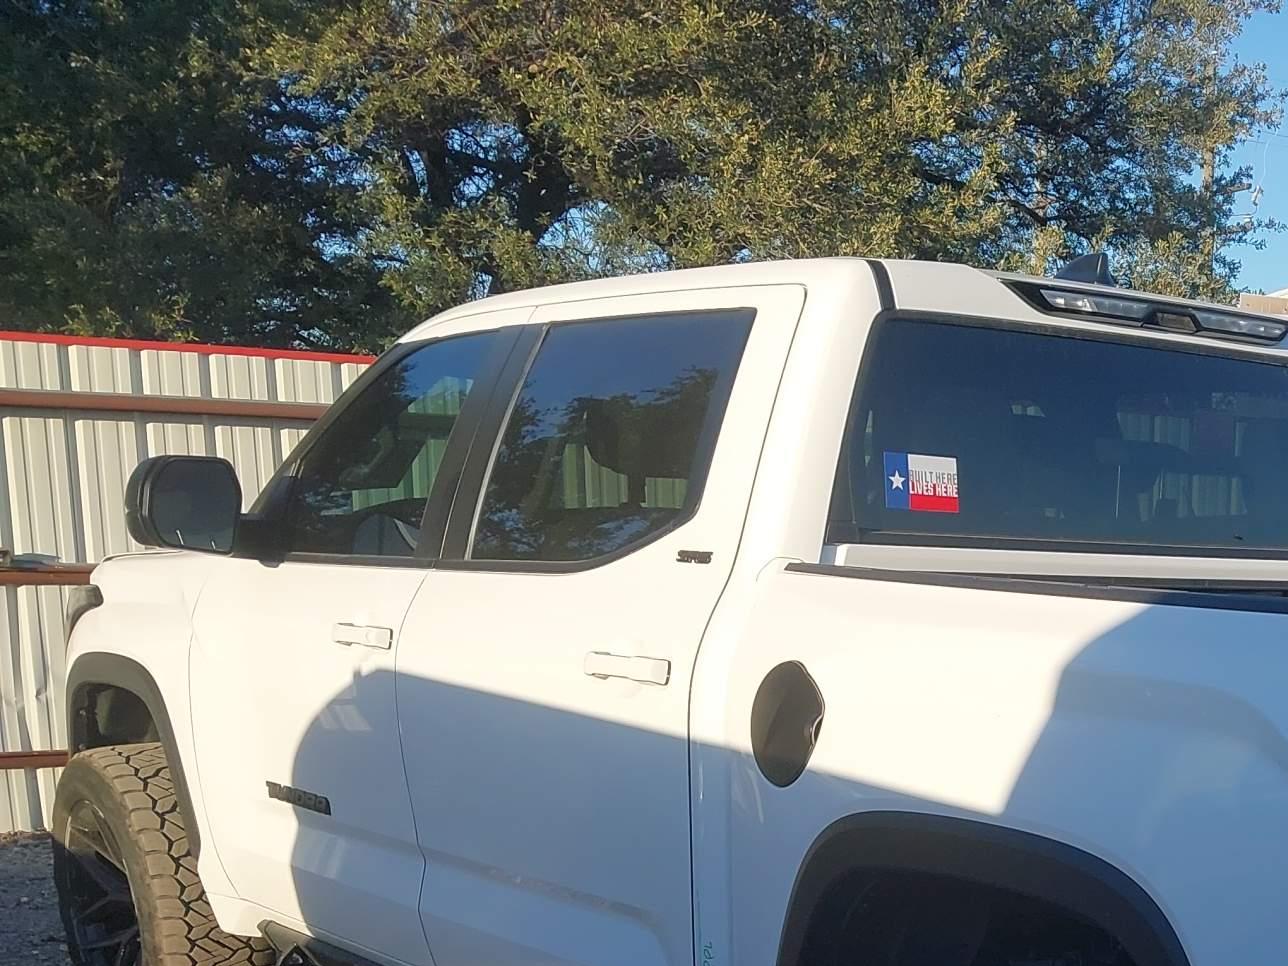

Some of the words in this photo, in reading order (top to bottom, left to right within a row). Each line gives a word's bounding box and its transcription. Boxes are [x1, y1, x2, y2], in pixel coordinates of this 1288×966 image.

[909, 470, 934, 484] BUILT
[936, 471, 957, 485] HERE
[910, 481, 934, 495] LIVES
[936, 484, 958, 497] HERE
